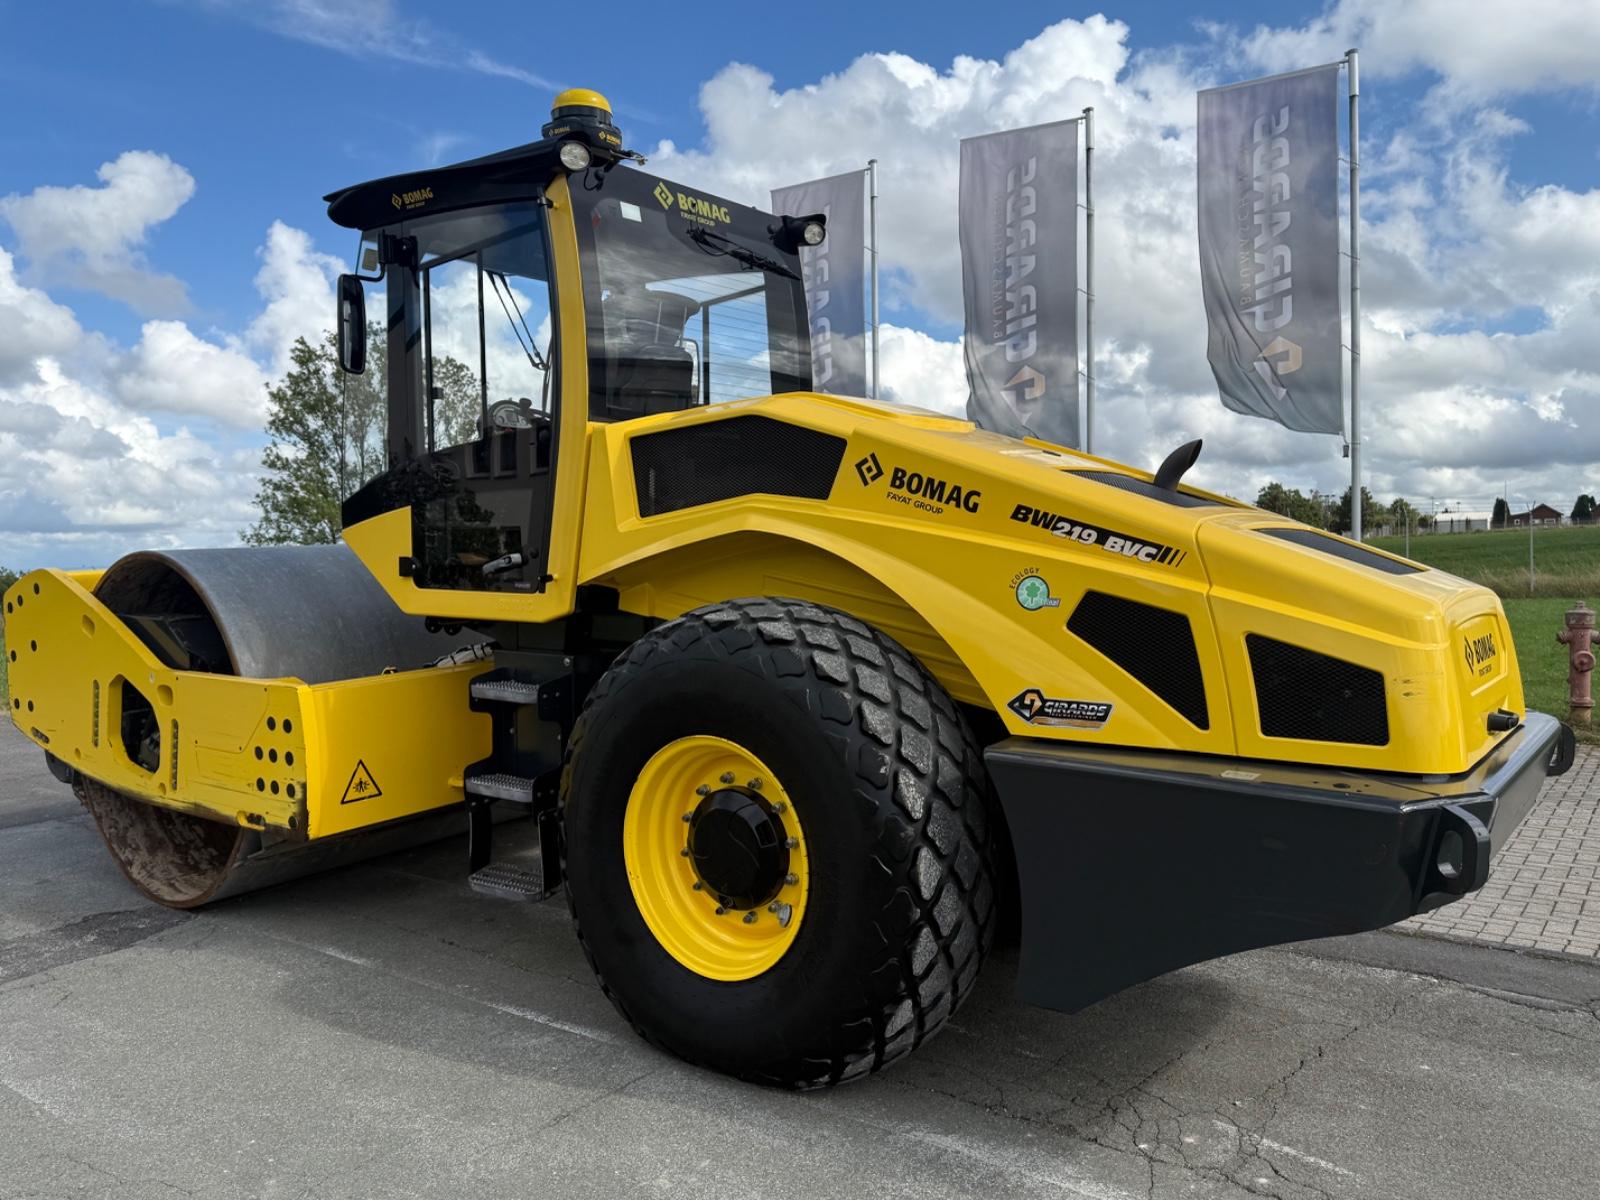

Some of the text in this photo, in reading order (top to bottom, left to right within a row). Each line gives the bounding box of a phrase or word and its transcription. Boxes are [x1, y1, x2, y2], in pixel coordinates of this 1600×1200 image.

[402, 187, 433, 205] BOMAG
[677, 192, 731, 224] BOMAG
[889, 466, 981, 513] BOMAG
[886, 491, 943, 514] FAYAT GROUP
[1103, 535, 1158, 563] BVC
[1009, 567, 1040, 590] ECOLOGY
[1044, 701, 1107, 717] GIRARDS
